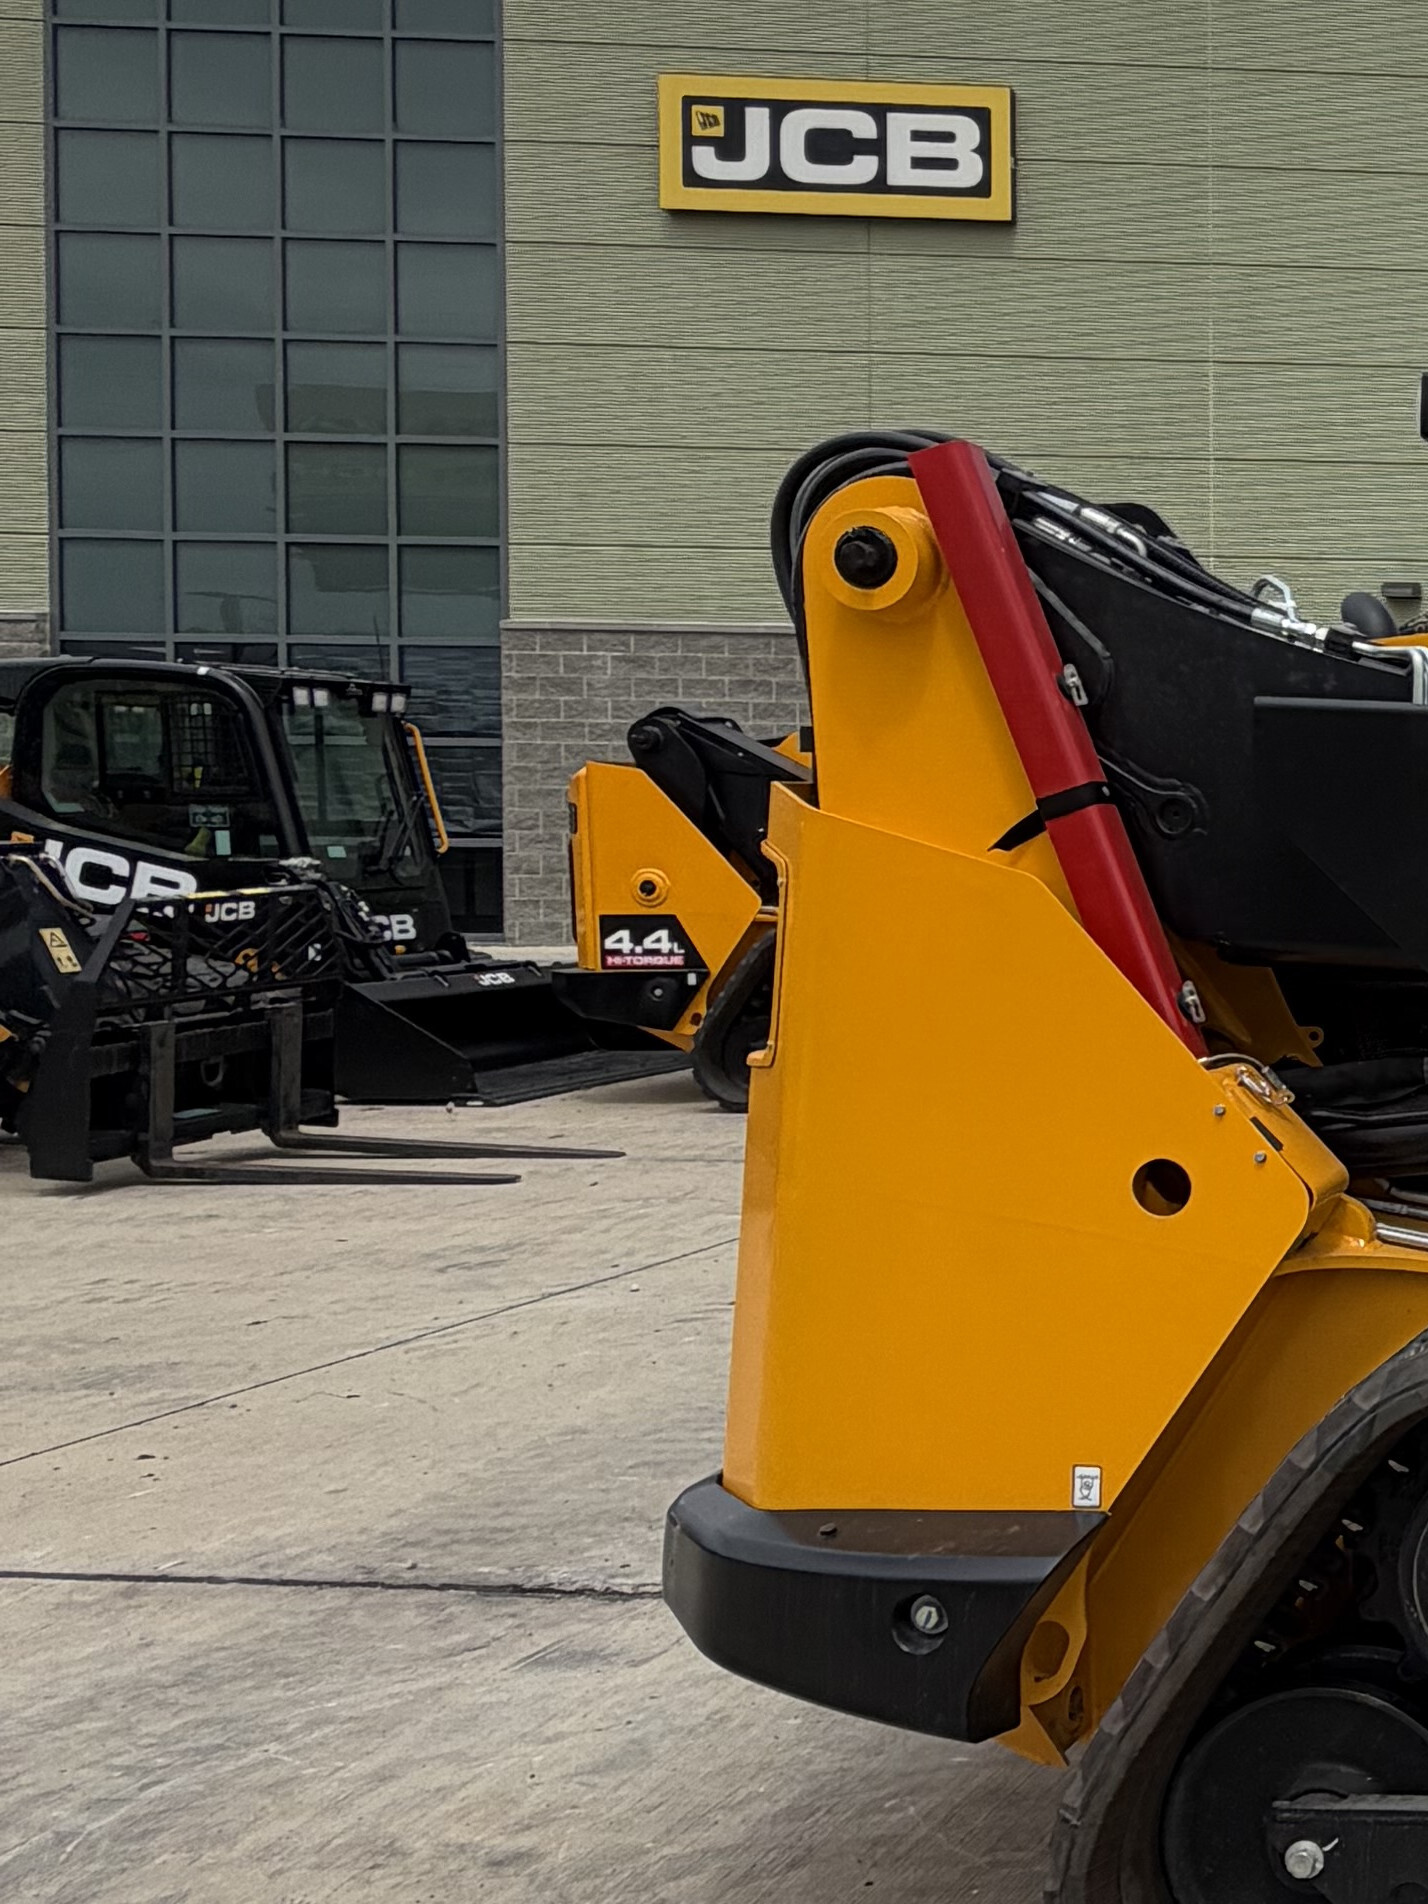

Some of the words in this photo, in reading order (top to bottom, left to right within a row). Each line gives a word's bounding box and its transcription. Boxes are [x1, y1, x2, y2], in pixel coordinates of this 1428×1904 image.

[691, 107, 984, 188] JCB
[204, 901, 256, 923] JCB
[606, 956, 684, 966] HI-TORQUE
[477, 972, 515, 986] JCB
